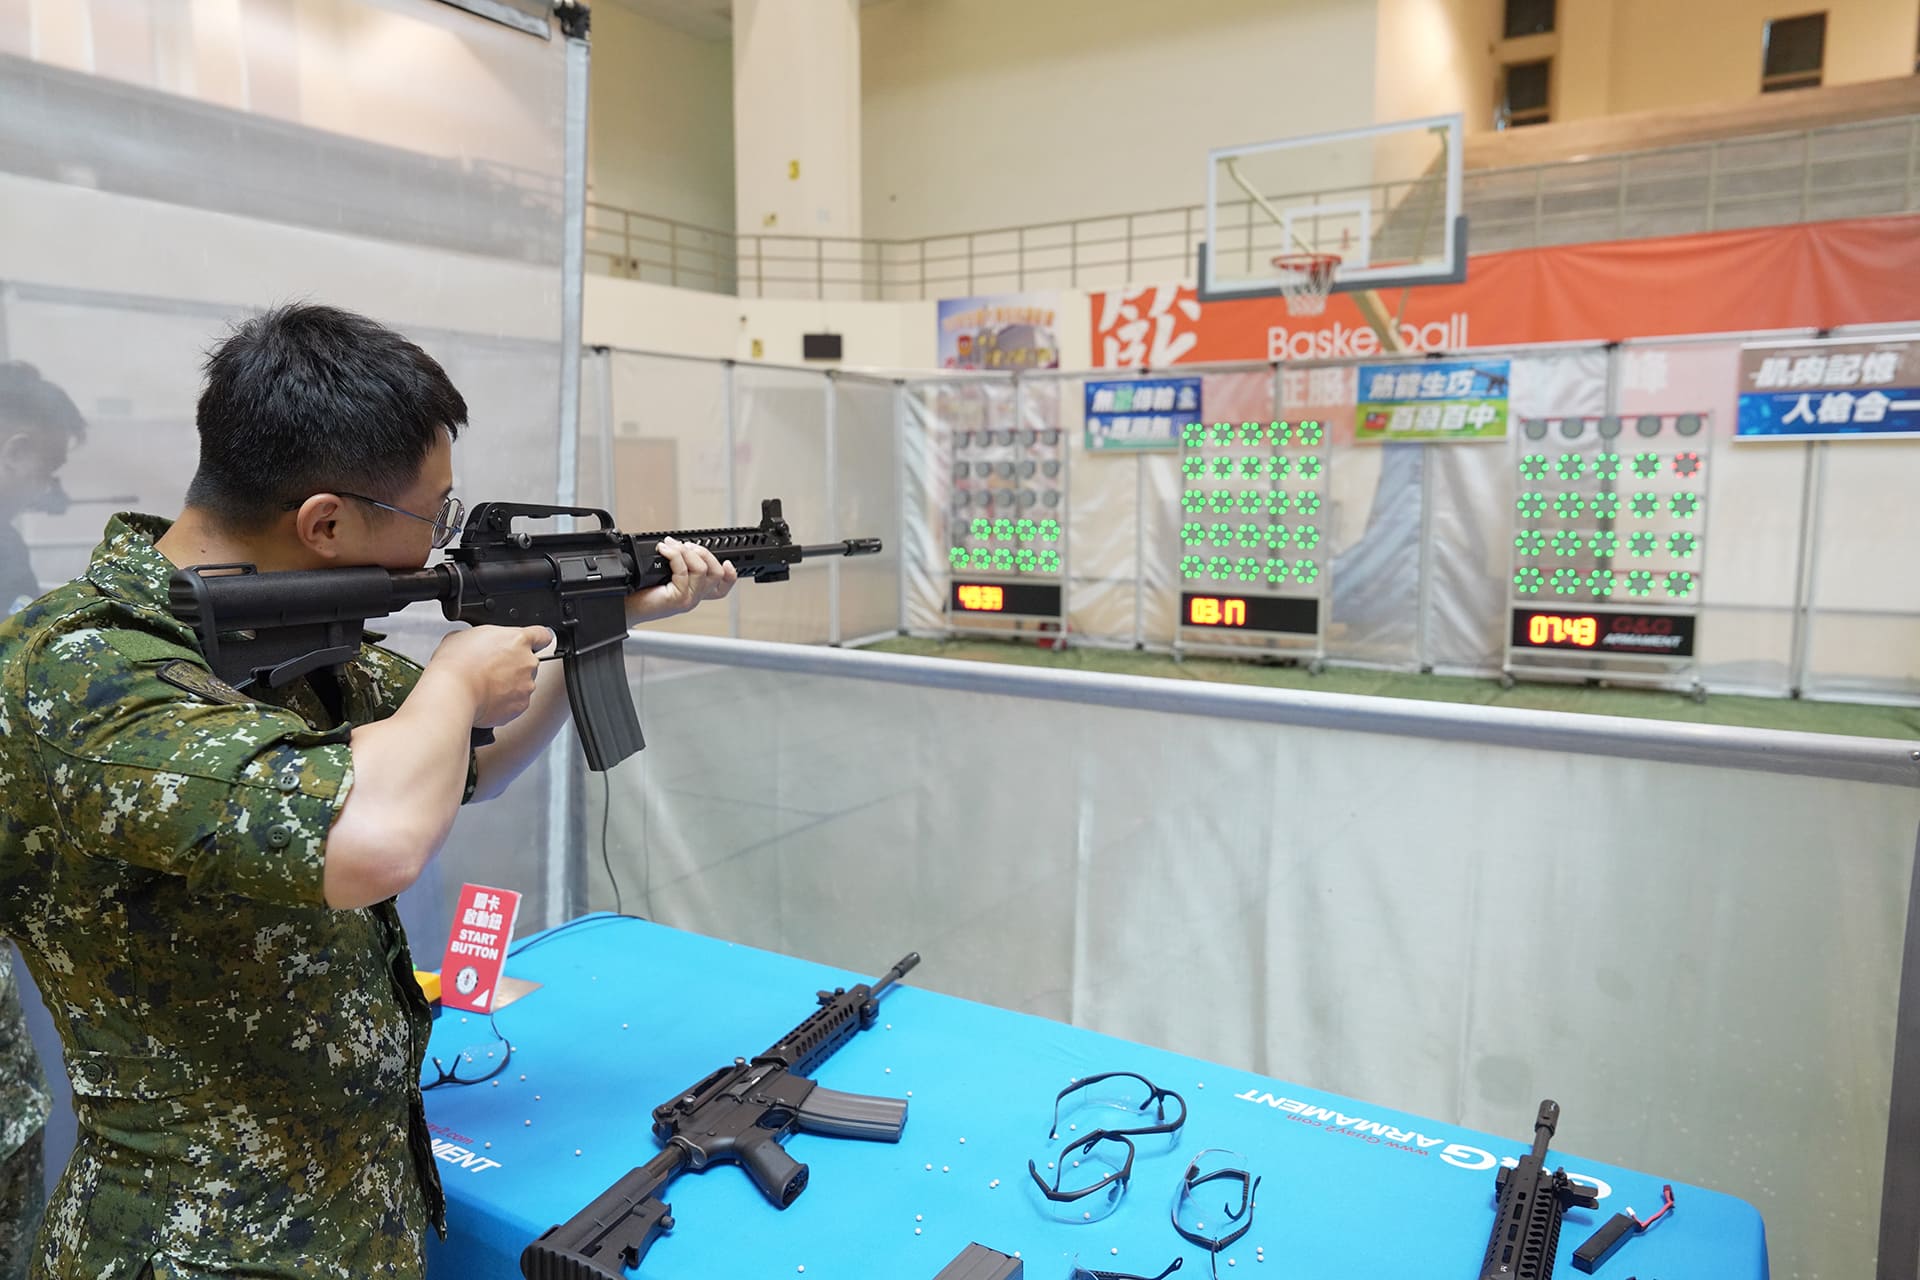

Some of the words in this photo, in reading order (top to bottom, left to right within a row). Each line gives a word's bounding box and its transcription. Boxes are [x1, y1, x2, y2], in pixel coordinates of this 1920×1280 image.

[1267, 312, 1468, 361] Baskeball
[450, 941, 499, 960] BUTTON
[459, 929, 498, 946] START
[1234, 1088, 1445, 1149] ARMAMENT
[431, 1138, 503, 1173] MENT
